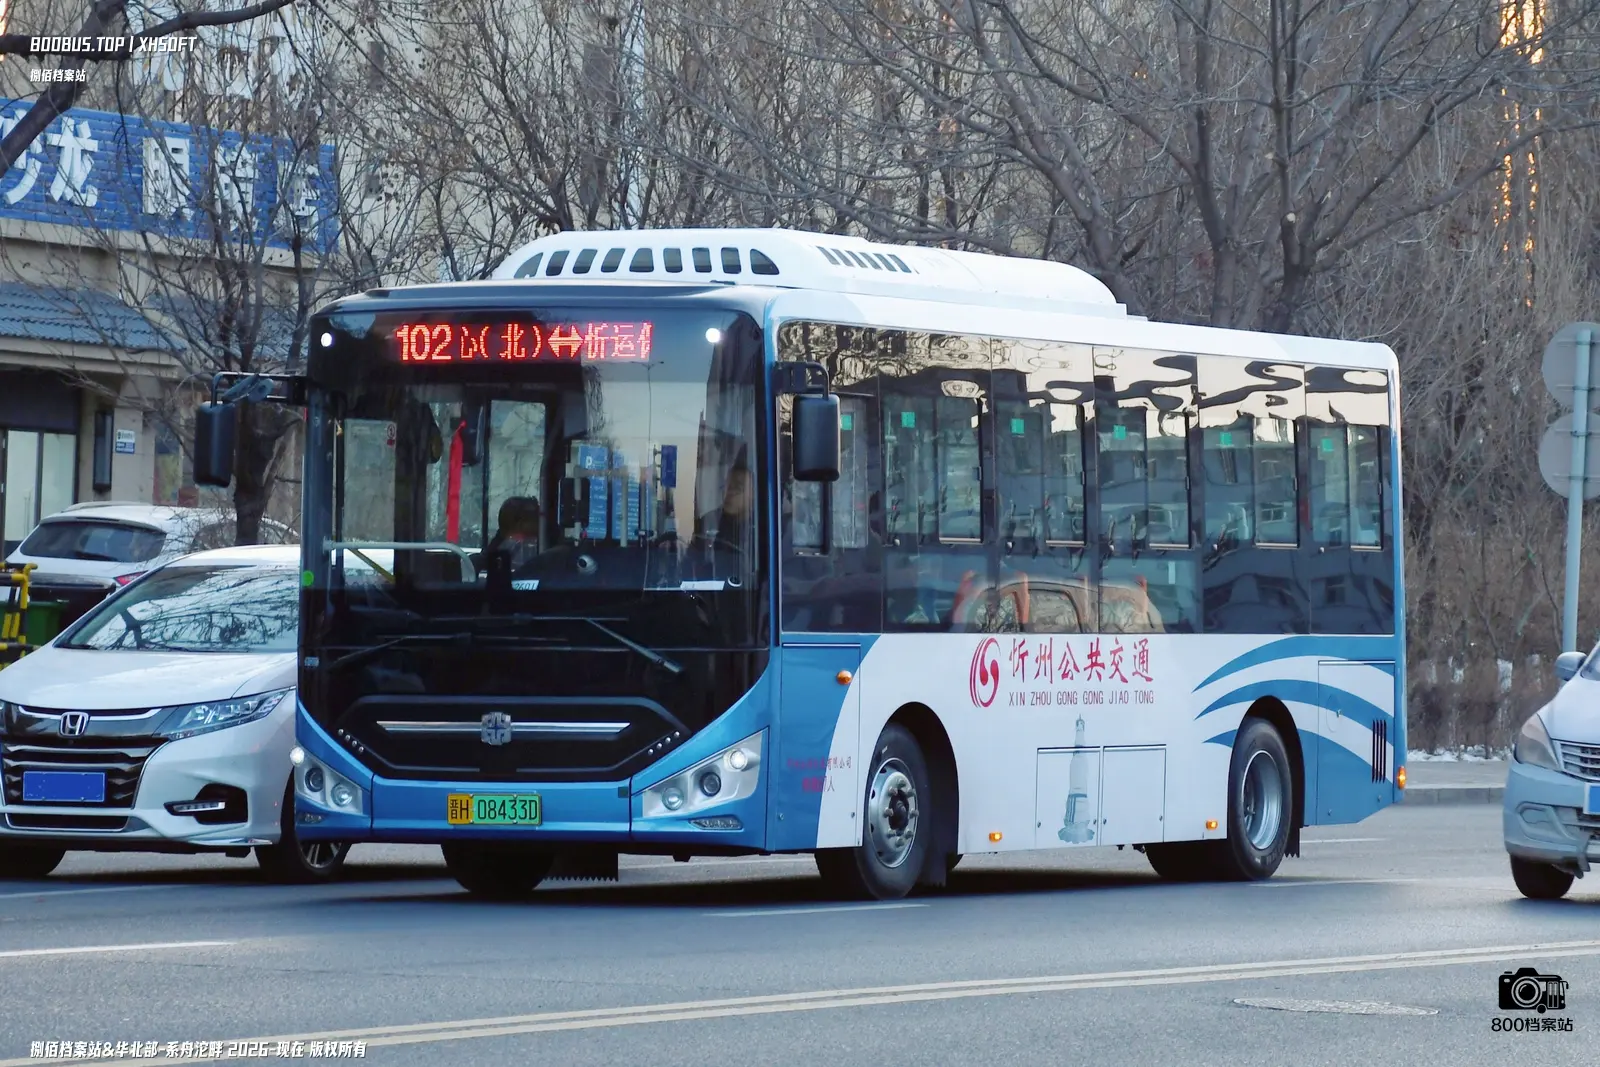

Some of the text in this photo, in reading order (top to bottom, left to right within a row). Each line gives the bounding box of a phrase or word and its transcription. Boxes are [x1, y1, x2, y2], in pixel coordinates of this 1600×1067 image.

[396, 323, 453, 361] 102
[1008, 637, 1154, 684] 忻州公共交通
[1008, 690, 1155, 706] XIN ZHOU GONG GONG JIAO TONG
